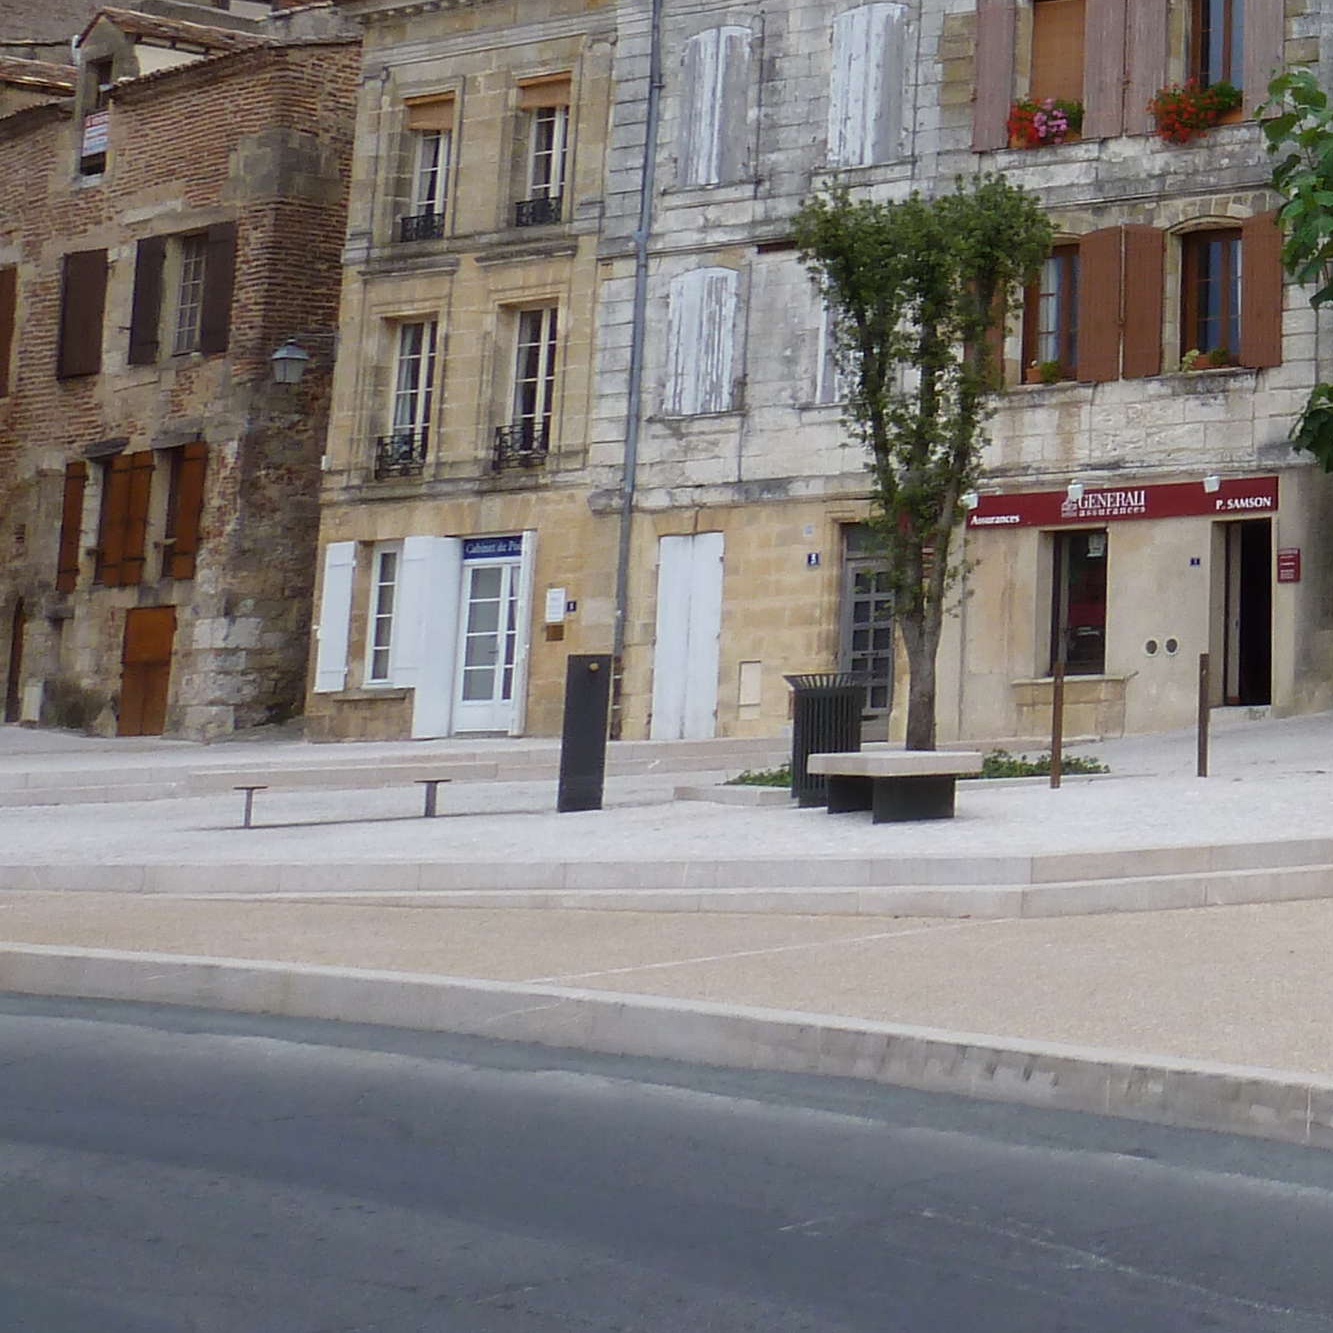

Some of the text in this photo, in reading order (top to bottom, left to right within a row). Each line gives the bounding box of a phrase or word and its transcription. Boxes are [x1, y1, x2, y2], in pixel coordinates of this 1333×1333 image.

[1078, 490, 1146, 509] GENERALI
[1227, 496, 1272, 510] SAMSON
[1078, 506, 1146, 518] assurances
[970, 514, 1020, 525] Assurances
[465, 542, 496, 554] Cabinet
[497, 541, 507, 553] de
